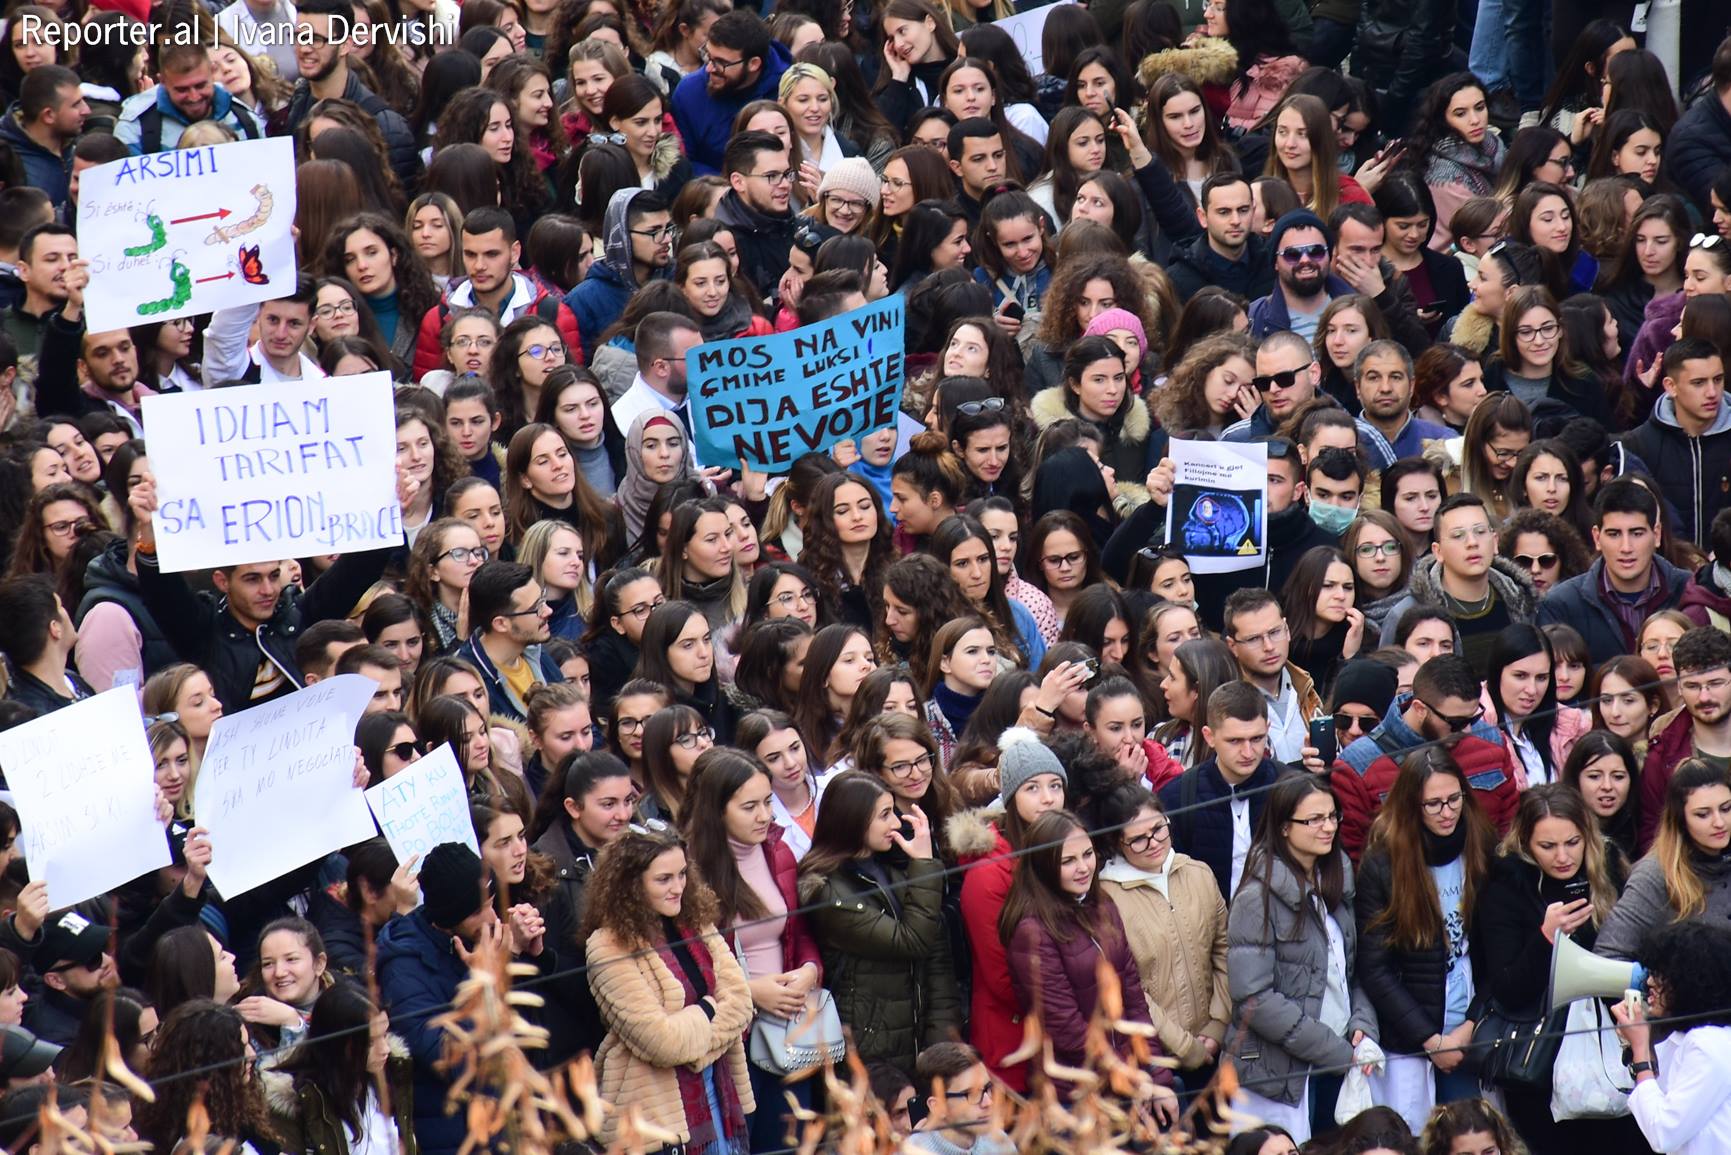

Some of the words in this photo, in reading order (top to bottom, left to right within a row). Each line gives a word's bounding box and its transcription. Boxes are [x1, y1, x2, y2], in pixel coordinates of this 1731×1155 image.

[115, 147, 218, 186] ARSIMI
[698, 344, 773, 373] MOS
[793, 328, 838, 358] NA
[851, 308, 899, 338] VINI
[705, 395, 800, 430] DIJA
[812, 352, 901, 410] ESHTE
[214, 398, 330, 443] DUAM
[733, 384, 897, 465] NEVOJE
[214, 435, 364, 481] TARIFAT
[160, 498, 206, 534] SA
[268, 716, 327, 761] LINDITA
[381, 775, 417, 817] ATY
[425, 765, 448, 787] KU
[402, 838, 426, 856] PO
